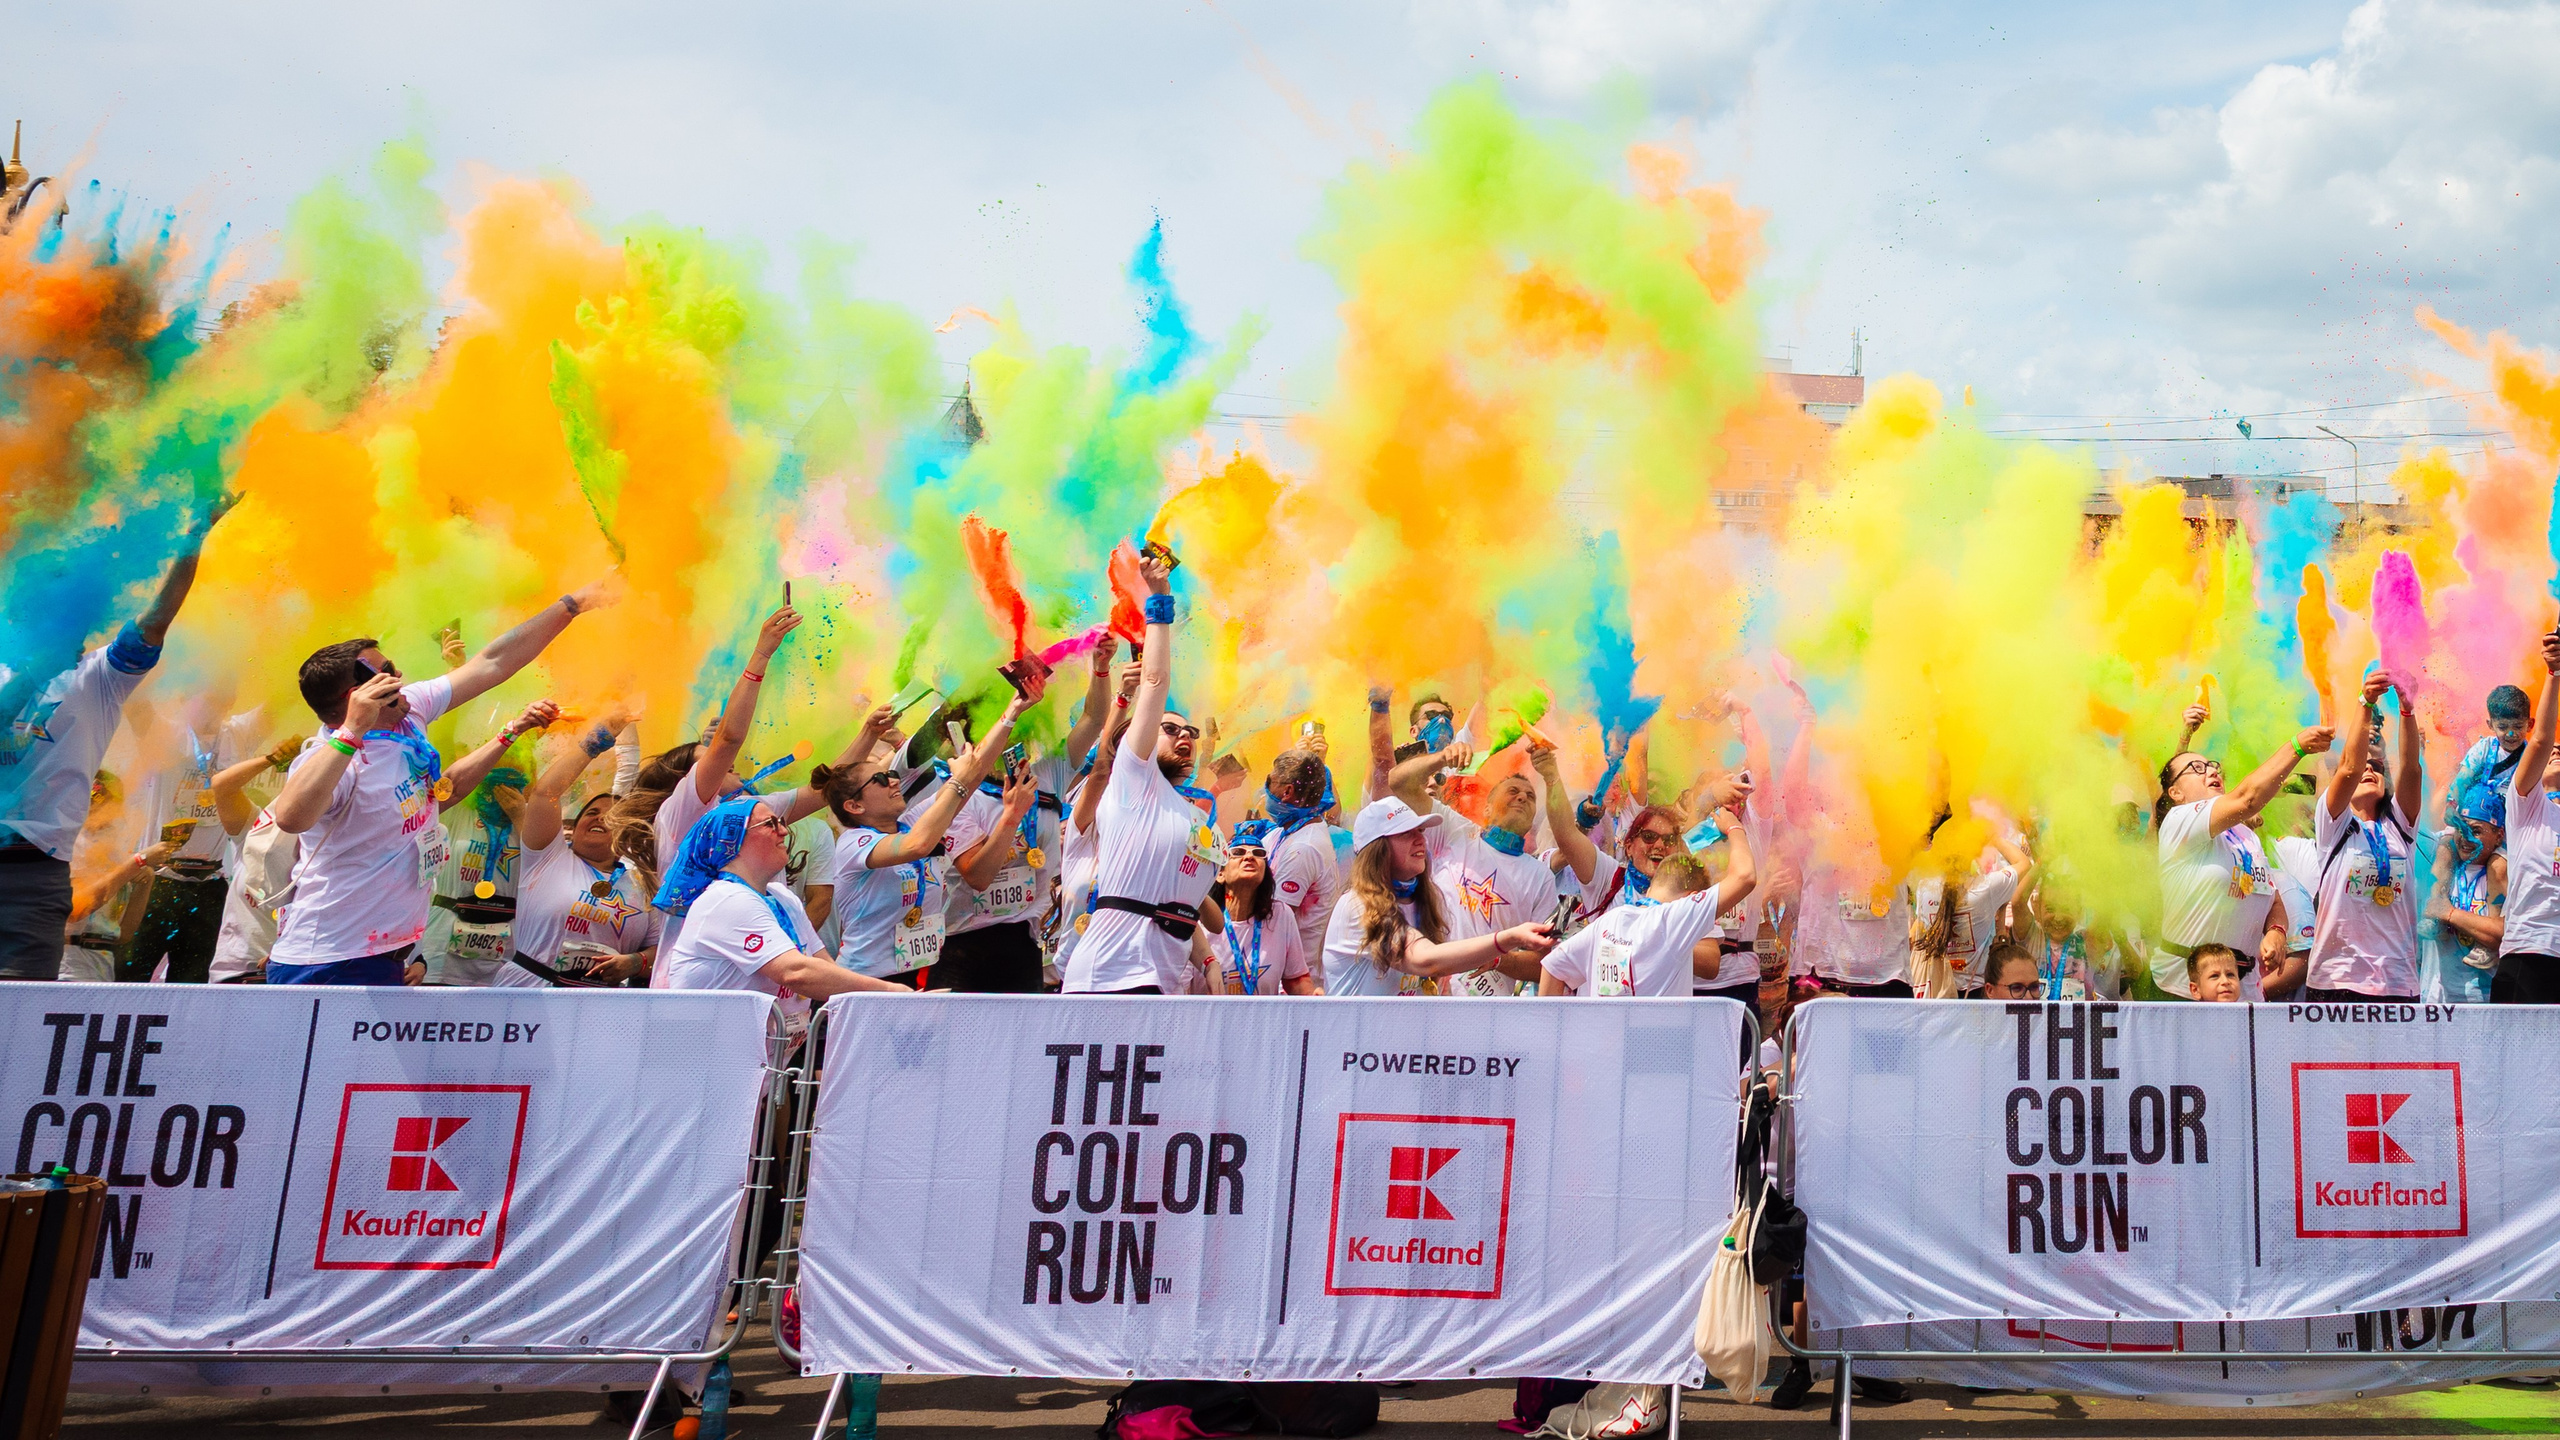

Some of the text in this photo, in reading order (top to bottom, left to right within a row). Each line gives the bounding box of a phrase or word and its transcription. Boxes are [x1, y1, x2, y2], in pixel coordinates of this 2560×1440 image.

[468, 839, 488, 856] THE
[462, 852, 487, 870] COL
[460, 867, 484, 883] RUN
[2250, 866, 2266, 882] 959
[990, 885, 1022, 906] 16138
[565, 915, 591, 935] RUN
[570, 901, 611, 926] COLOR
[464, 933, 497, 950] 18462
[909, 933, 938, 957] 16139
[1758, 952, 1778, 964] 5653
[1601, 963, 1619, 983] 8119
[1474, 975, 1496, 997] 1812
[2288, 1004, 2456, 1023] POWERED BY
[351, 1021, 542, 1044] POWERED BY
[2006, 1003, 2121, 1081] THE
[43, 1013, 169, 1098] THE
[1342, 1051, 1522, 1078] POWERED BY
[1045, 1044, 1165, 1126] THE
[2005, 1085, 2209, 1167] COLOR
[15, 1102, 246, 1189] COLOR
[1031, 1131, 1248, 1216] COLOR
[2315, 1181, 2448, 1207] Kaufland
[342, 1209, 488, 1237] Kaufland
[2007, 1172, 2130, 1255] RUN
[1022, 1220, 1157, 1305] RUN
[1347, 1236, 1485, 1267] Kaufland
